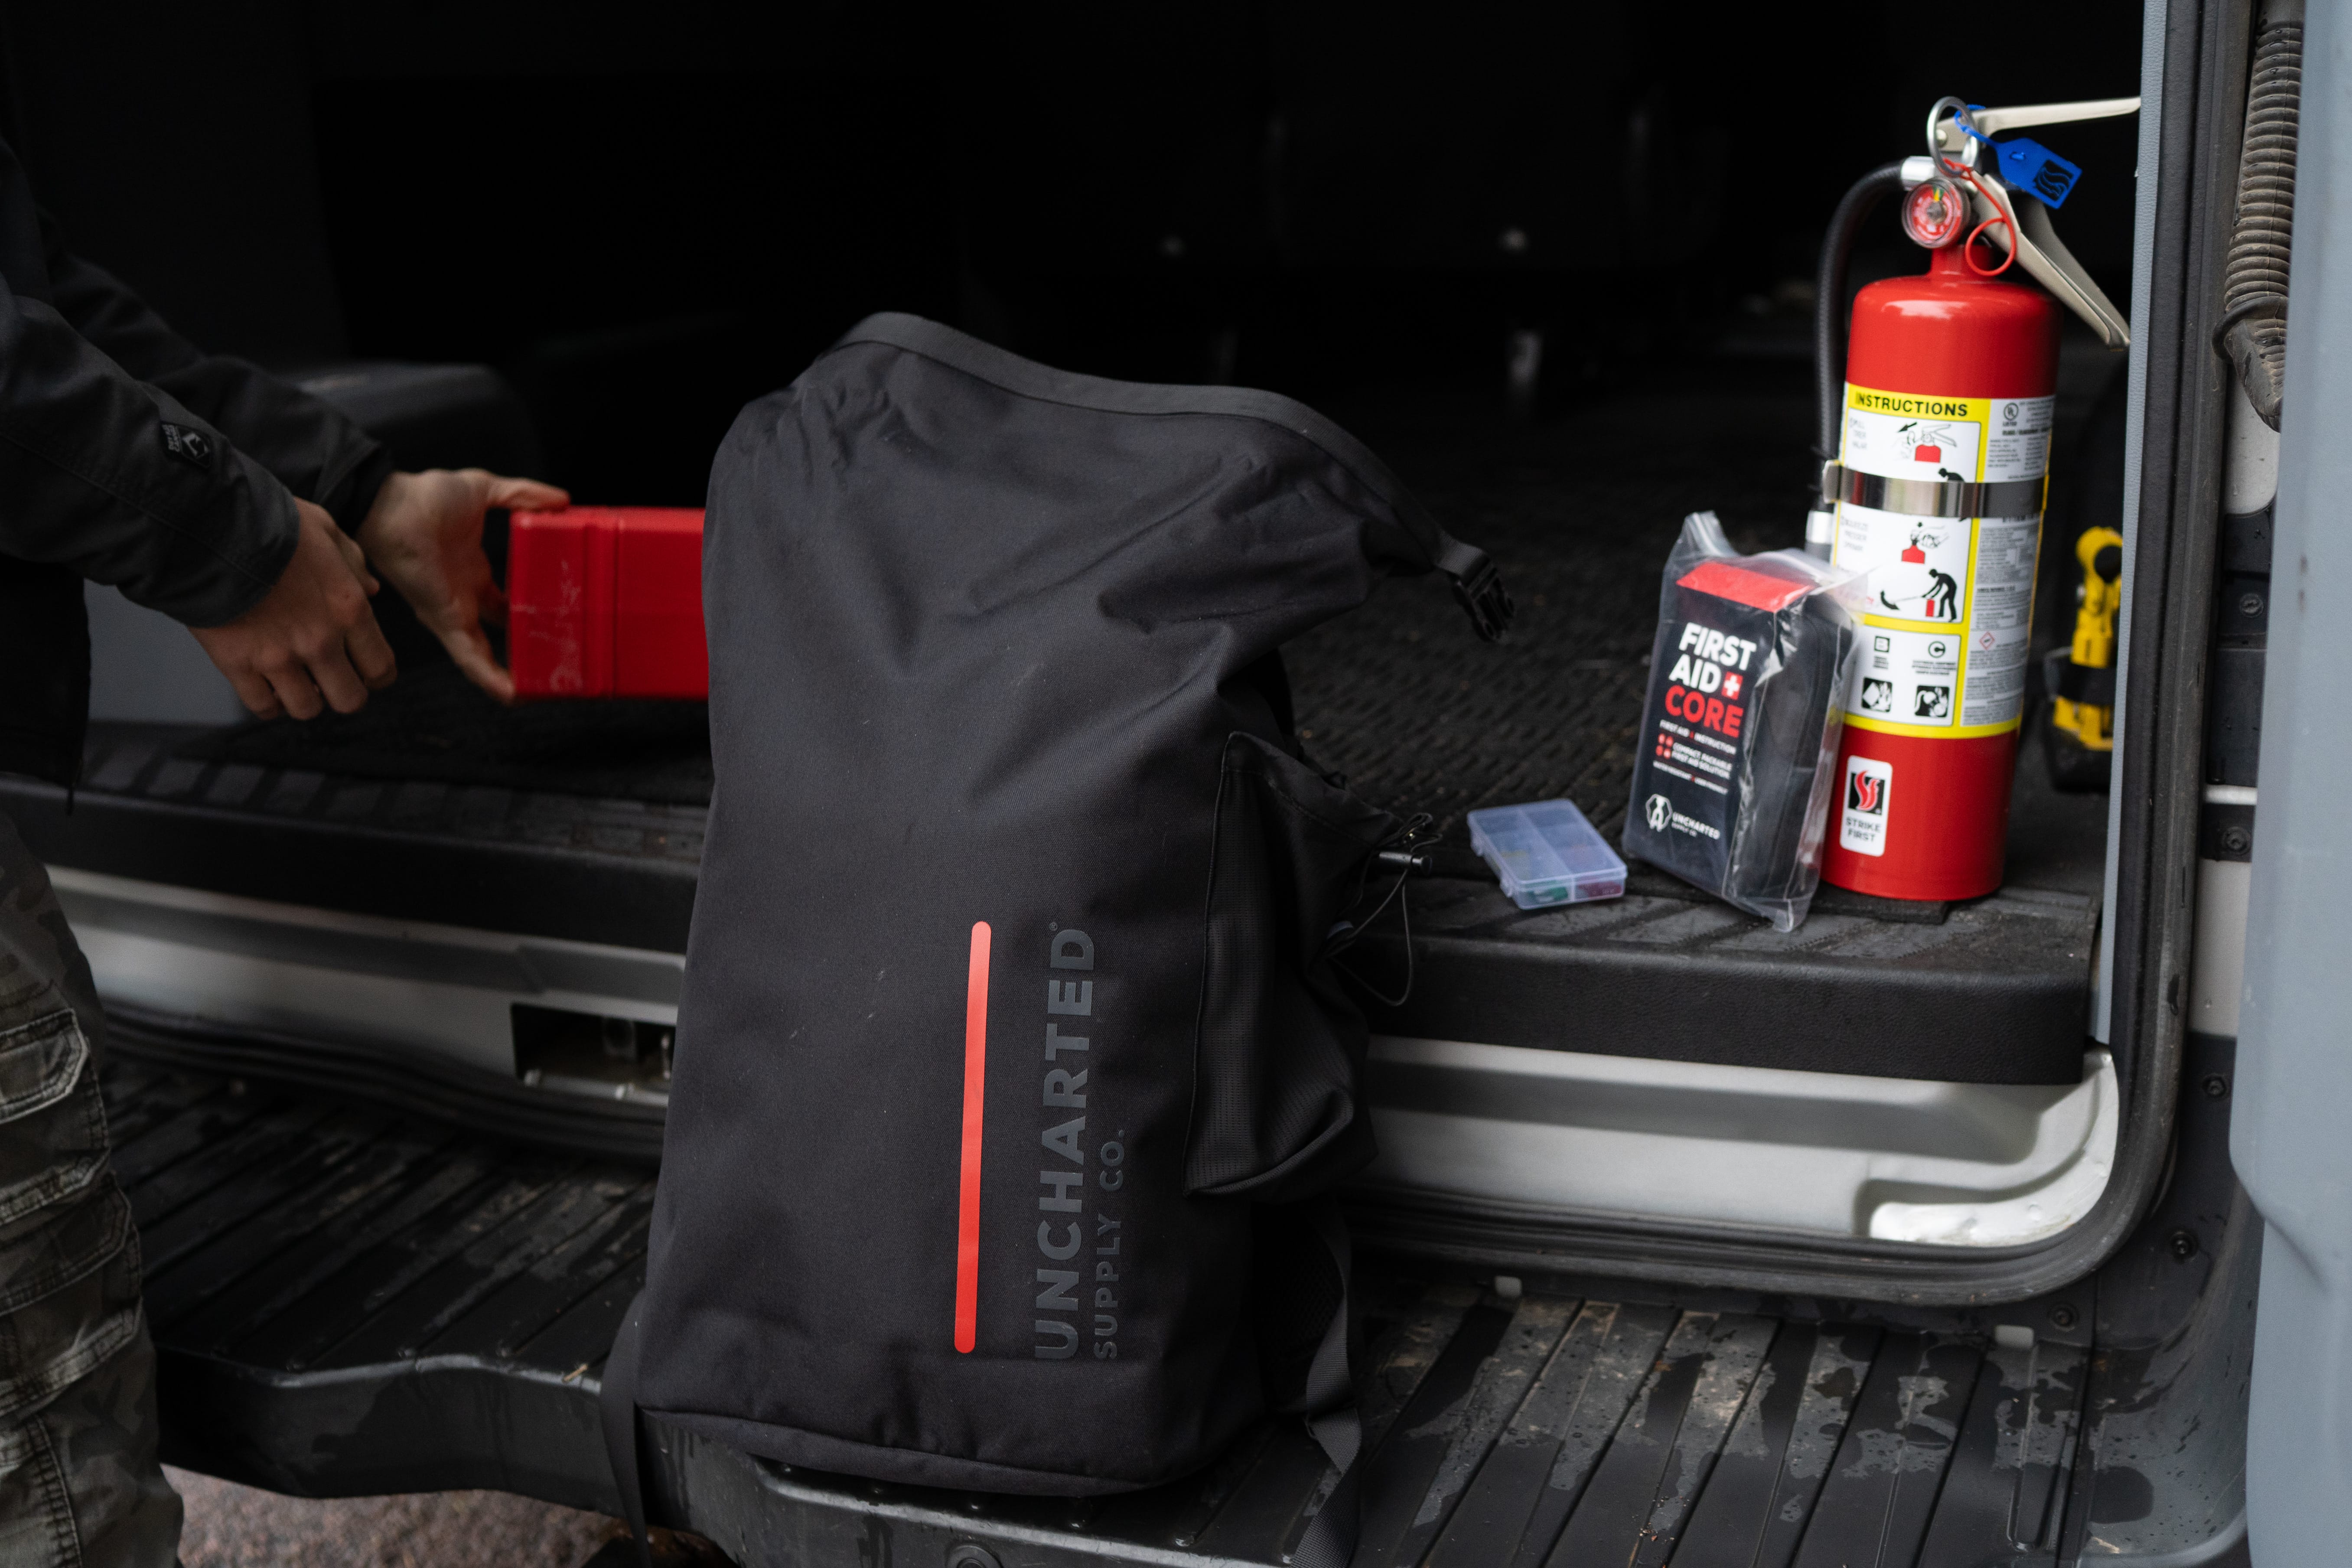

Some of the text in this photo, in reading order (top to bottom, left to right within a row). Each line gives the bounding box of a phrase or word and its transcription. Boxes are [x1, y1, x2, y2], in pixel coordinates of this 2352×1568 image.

[1855, 392, 1968, 417] INSTRUCTIONS
[1679, 622, 1757, 671] FIRST
[1668, 654, 1721, 693] AID
[1665, 685, 1743, 738] CORE
[1672, 812, 1720, 840] UNCHARTED
[1846, 816, 1881, 833] STRIKE
[1848, 828, 1876, 842] FIRST
[1035, 929, 1094, 1359] UNCHARTED
[1094, 1130, 1124, 1359] SUPPLY CO.
